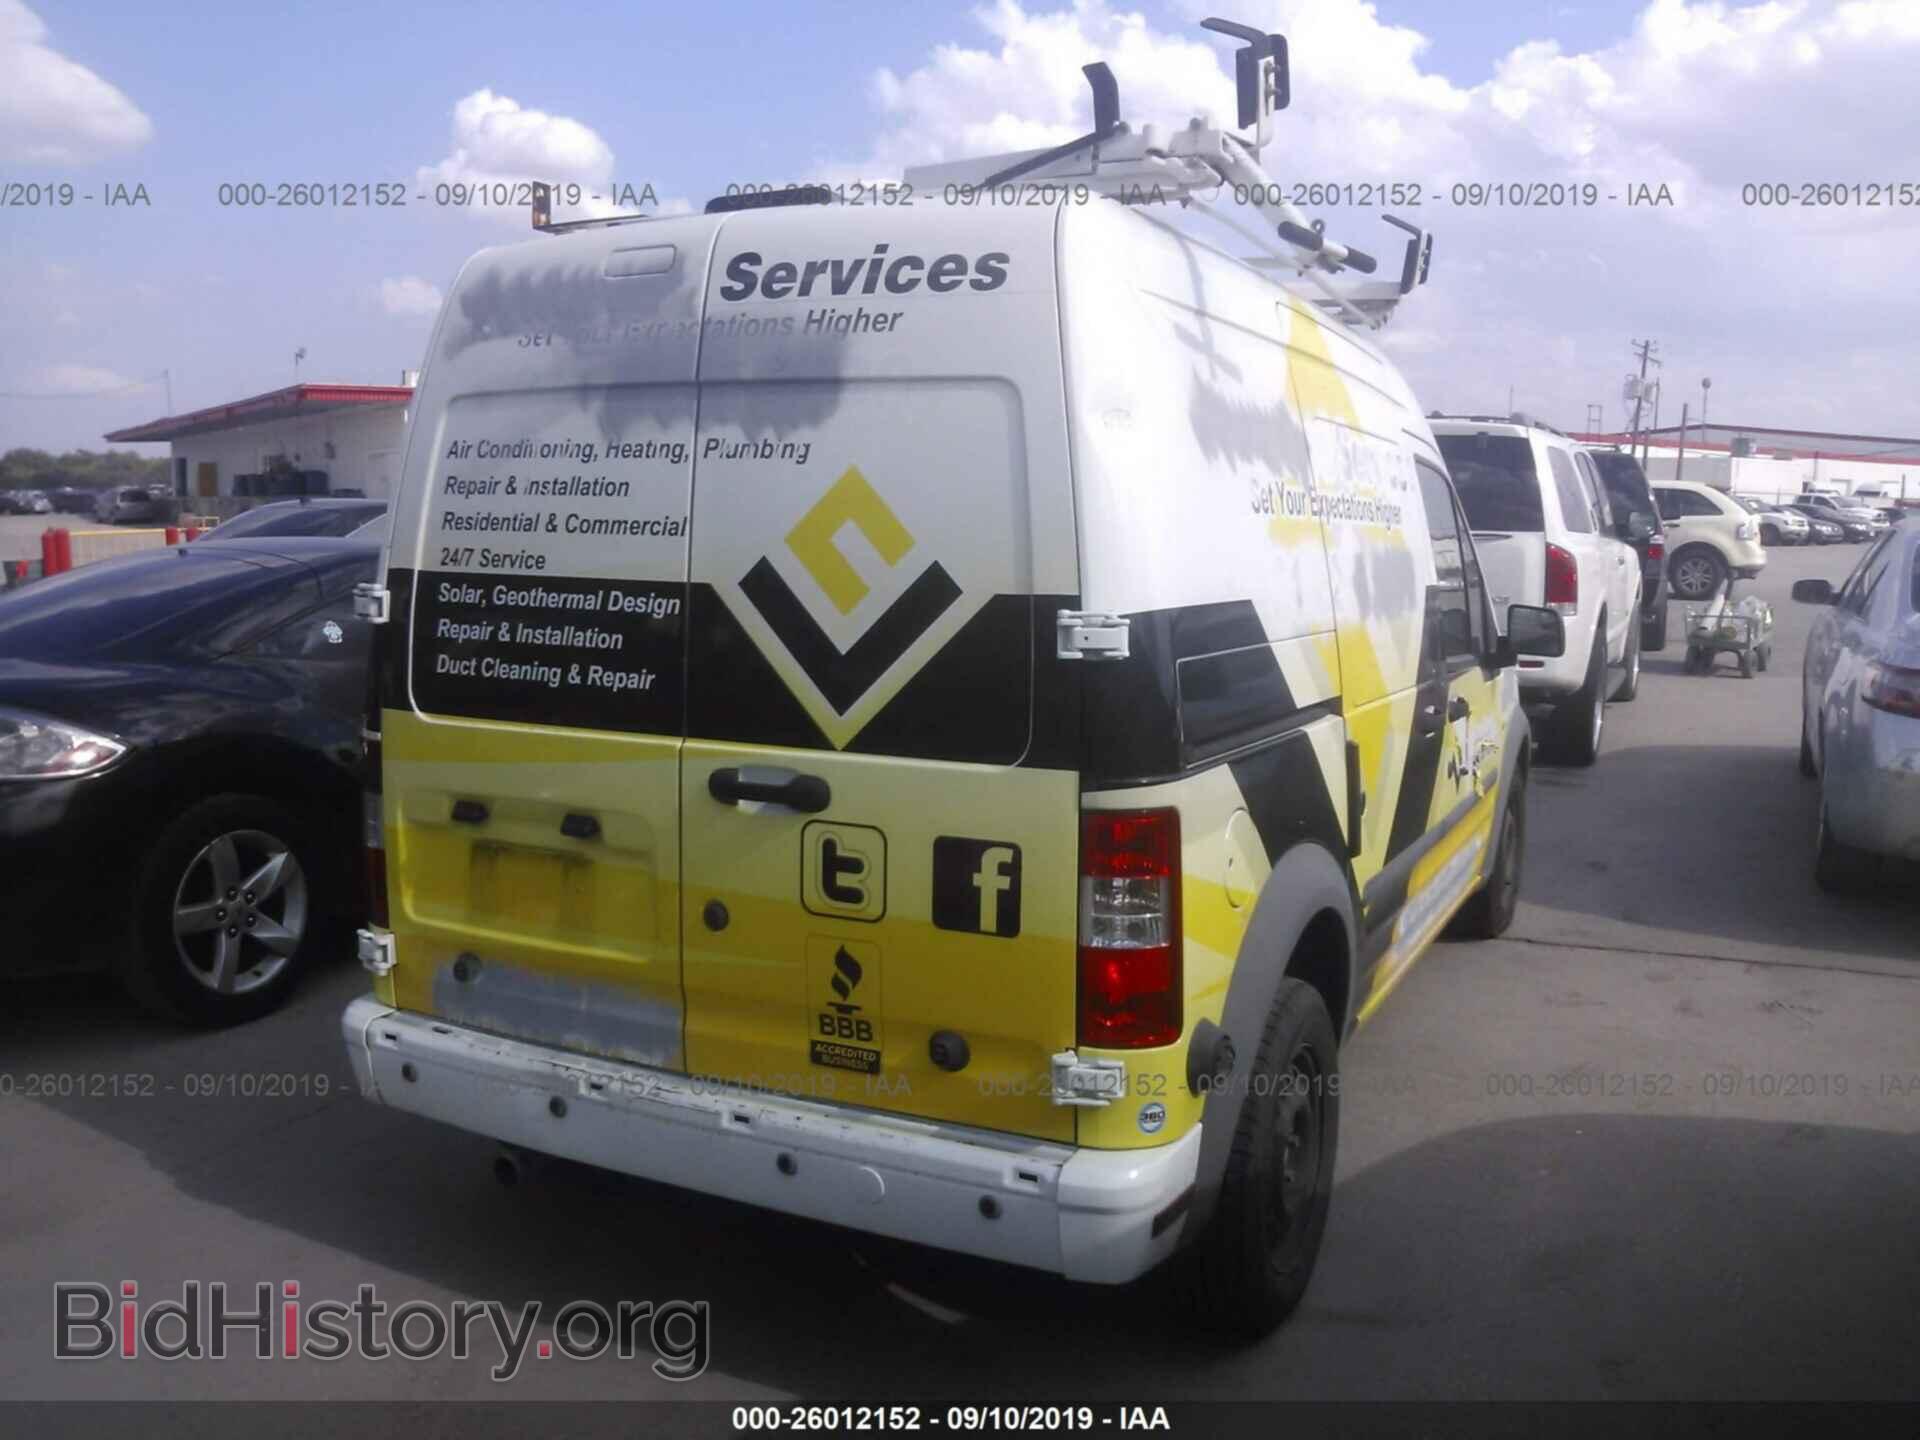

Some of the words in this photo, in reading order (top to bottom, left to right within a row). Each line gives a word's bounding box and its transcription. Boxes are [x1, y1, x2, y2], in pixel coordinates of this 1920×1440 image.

[720, 244, 1010, 301] Services
[803, 308, 904, 337] Higher
[447, 438, 473, 459] Air
[605, 440, 690, 464] Heating,
[704, 438, 811, 465] Plumbing
[444, 476, 501, 500] Repair
[505, 476, 518, 496] &
[1275, 480, 1306, 516] Your
[442, 511, 540, 533] Residential
[545, 513, 558, 534] &
[565, 513, 687, 538] Commercial
[440, 547, 475, 568] 24/7
[479, 548, 546, 570] Service
[438, 582, 487, 608] Solar,
[492, 585, 602, 611] Geothermal
[607, 590, 681, 619] Design
[437, 618, 494, 643] Repair
[498, 621, 511, 643] &
[516, 622, 623, 650] Installation
[436, 654, 477, 677] Duct
[481, 657, 561, 687] Cleaning
[567, 664, 581, 684] &
[587, 664, 655, 692] Repair
[819, 1014, 873, 1041] BBB
